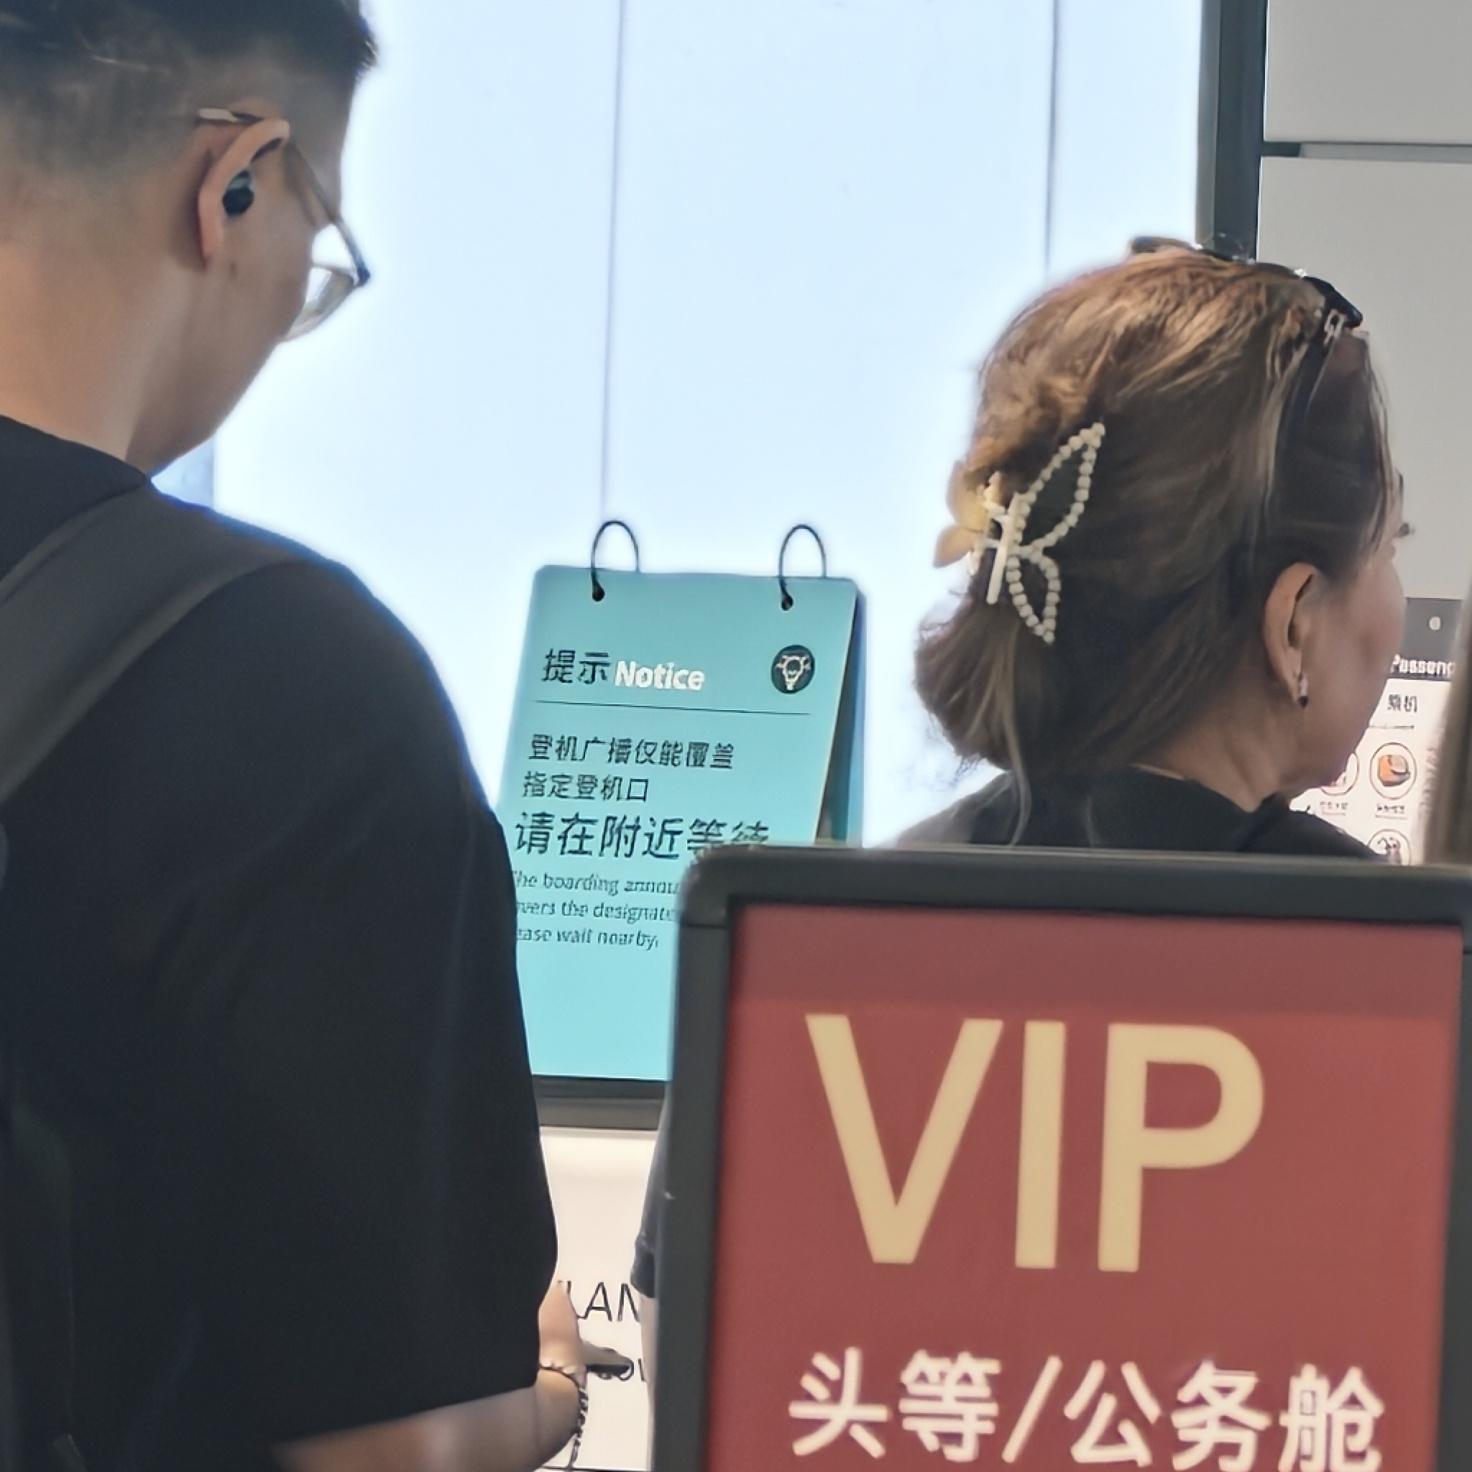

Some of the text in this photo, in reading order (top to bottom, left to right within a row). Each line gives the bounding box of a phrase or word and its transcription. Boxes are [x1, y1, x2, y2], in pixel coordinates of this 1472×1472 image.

[541, 648, 704, 691] 提示 Notice
[528, 734, 734, 769] 登机广播仅能覆盖
[523, 771, 649, 801] 指定登机口
[544, 873, 618, 896] boarding
[562, 900, 588, 917] the
[557, 928, 592, 943] wait
[805, 1013, 1264, 1273] VIP
